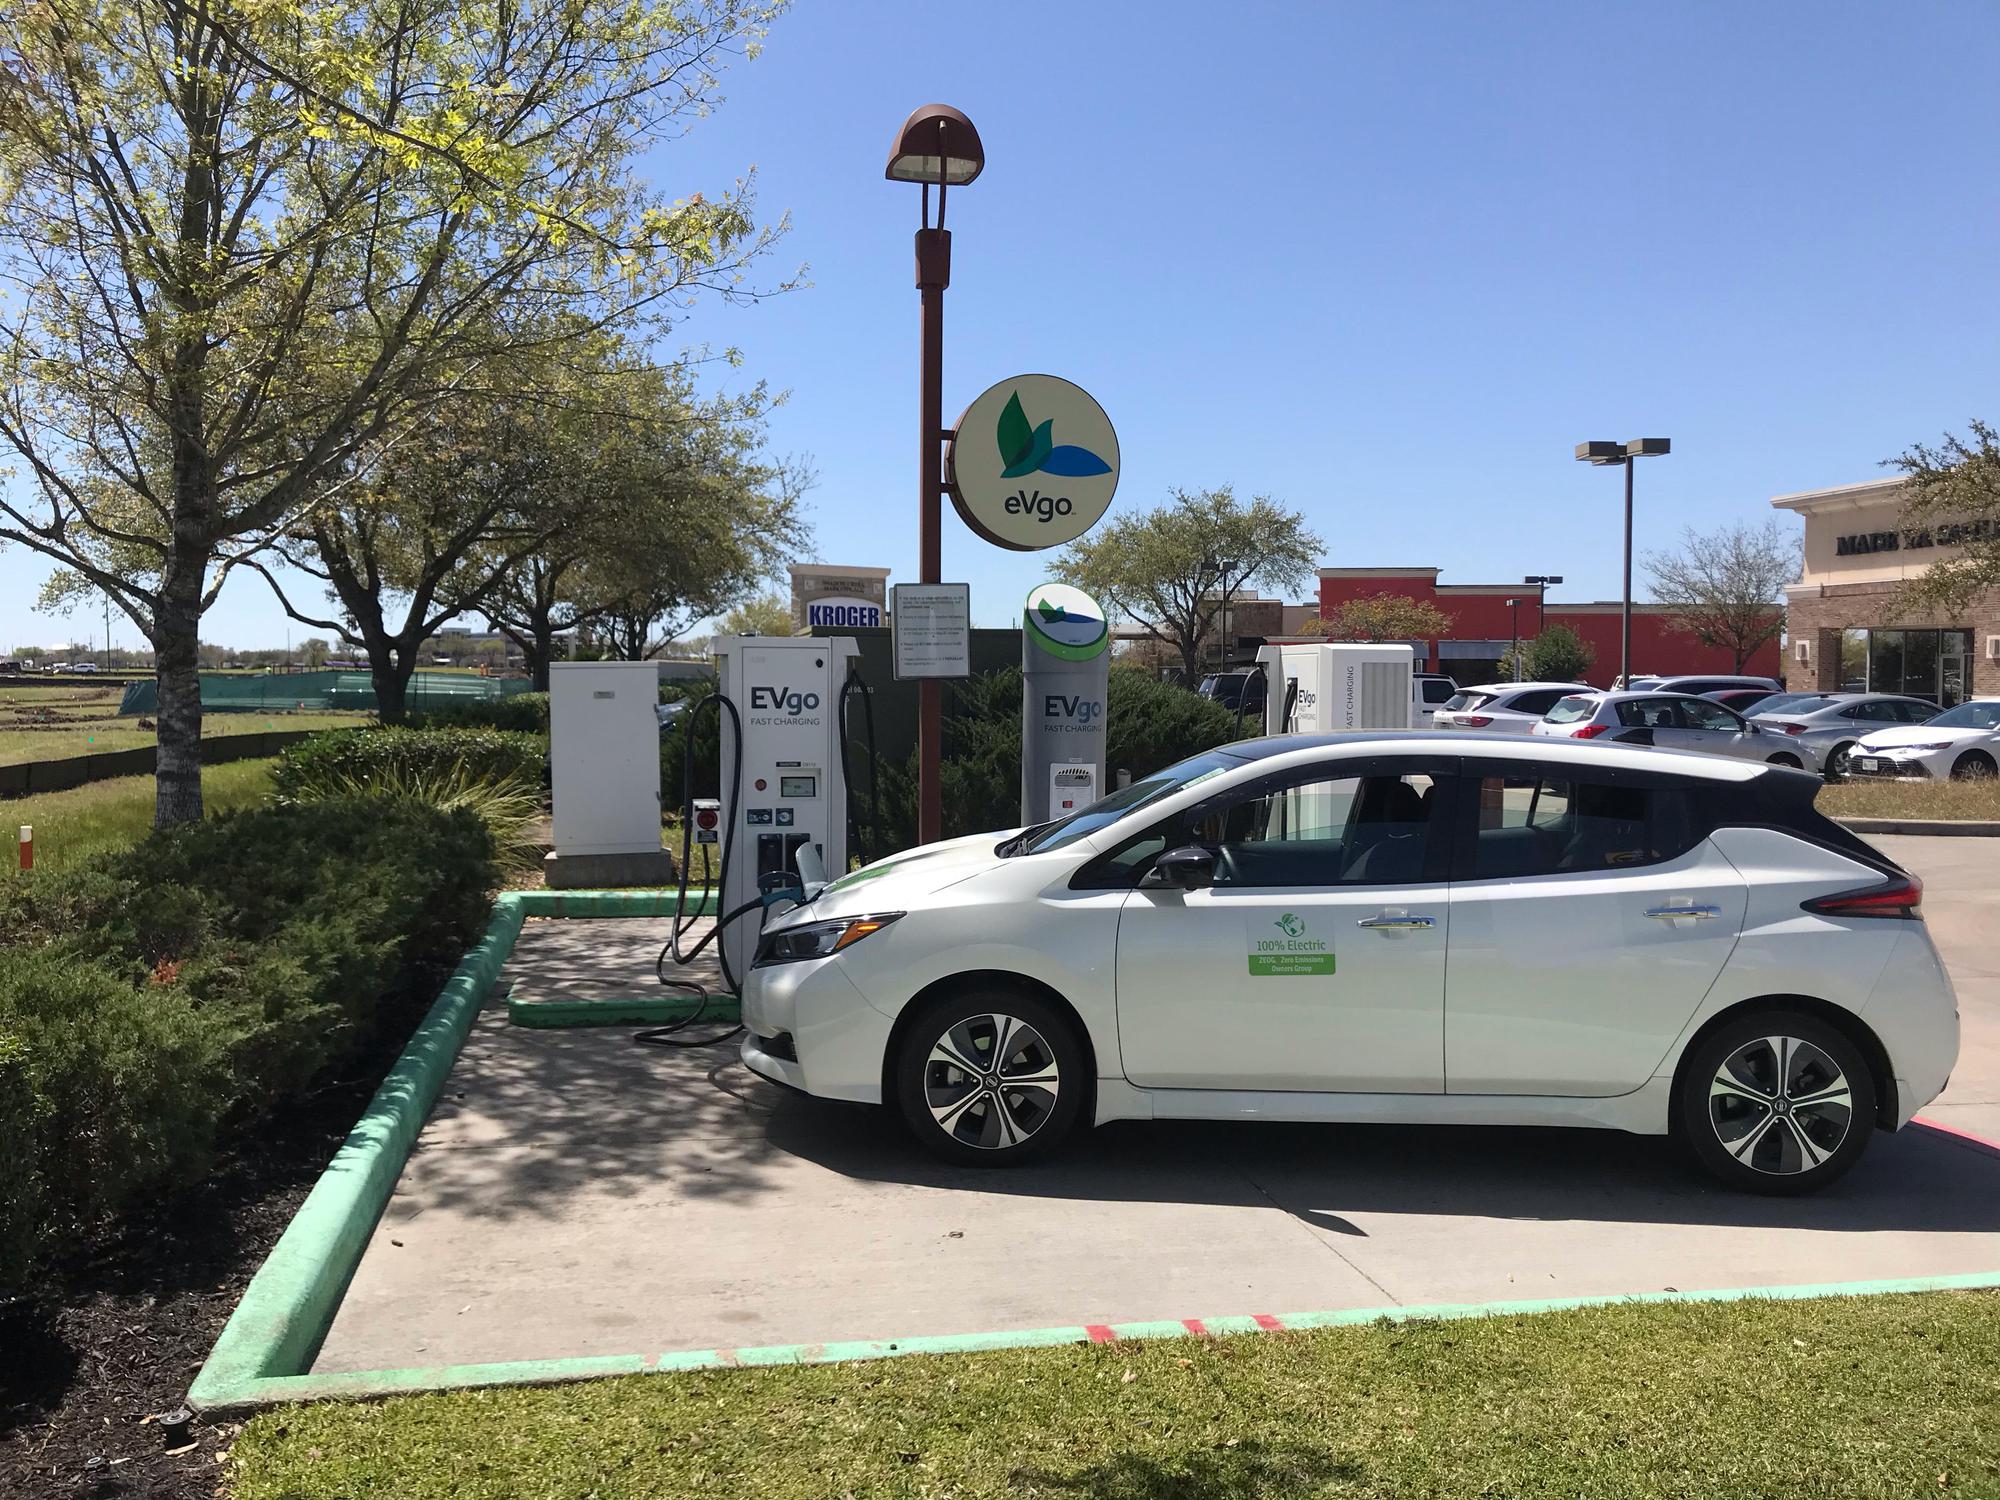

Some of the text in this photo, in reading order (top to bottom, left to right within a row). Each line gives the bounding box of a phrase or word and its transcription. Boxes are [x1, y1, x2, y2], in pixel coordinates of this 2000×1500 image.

[1004, 490, 1073, 523] eVgo
[809, 605, 879, 627] KROGER
[1346, 666, 1354, 709] CHARGING
[751, 687, 820, 716] EVgo
[1299, 690, 1316, 707] EVgo
[1045, 695, 1102, 723] EVgo
[751, 718, 820, 726] FAST CHARGING
[1044, 725, 1102, 733] FAST CHARGING
[1257, 940, 1327, 951] 100% Electric
[1294, 965, 1312, 974] Group
